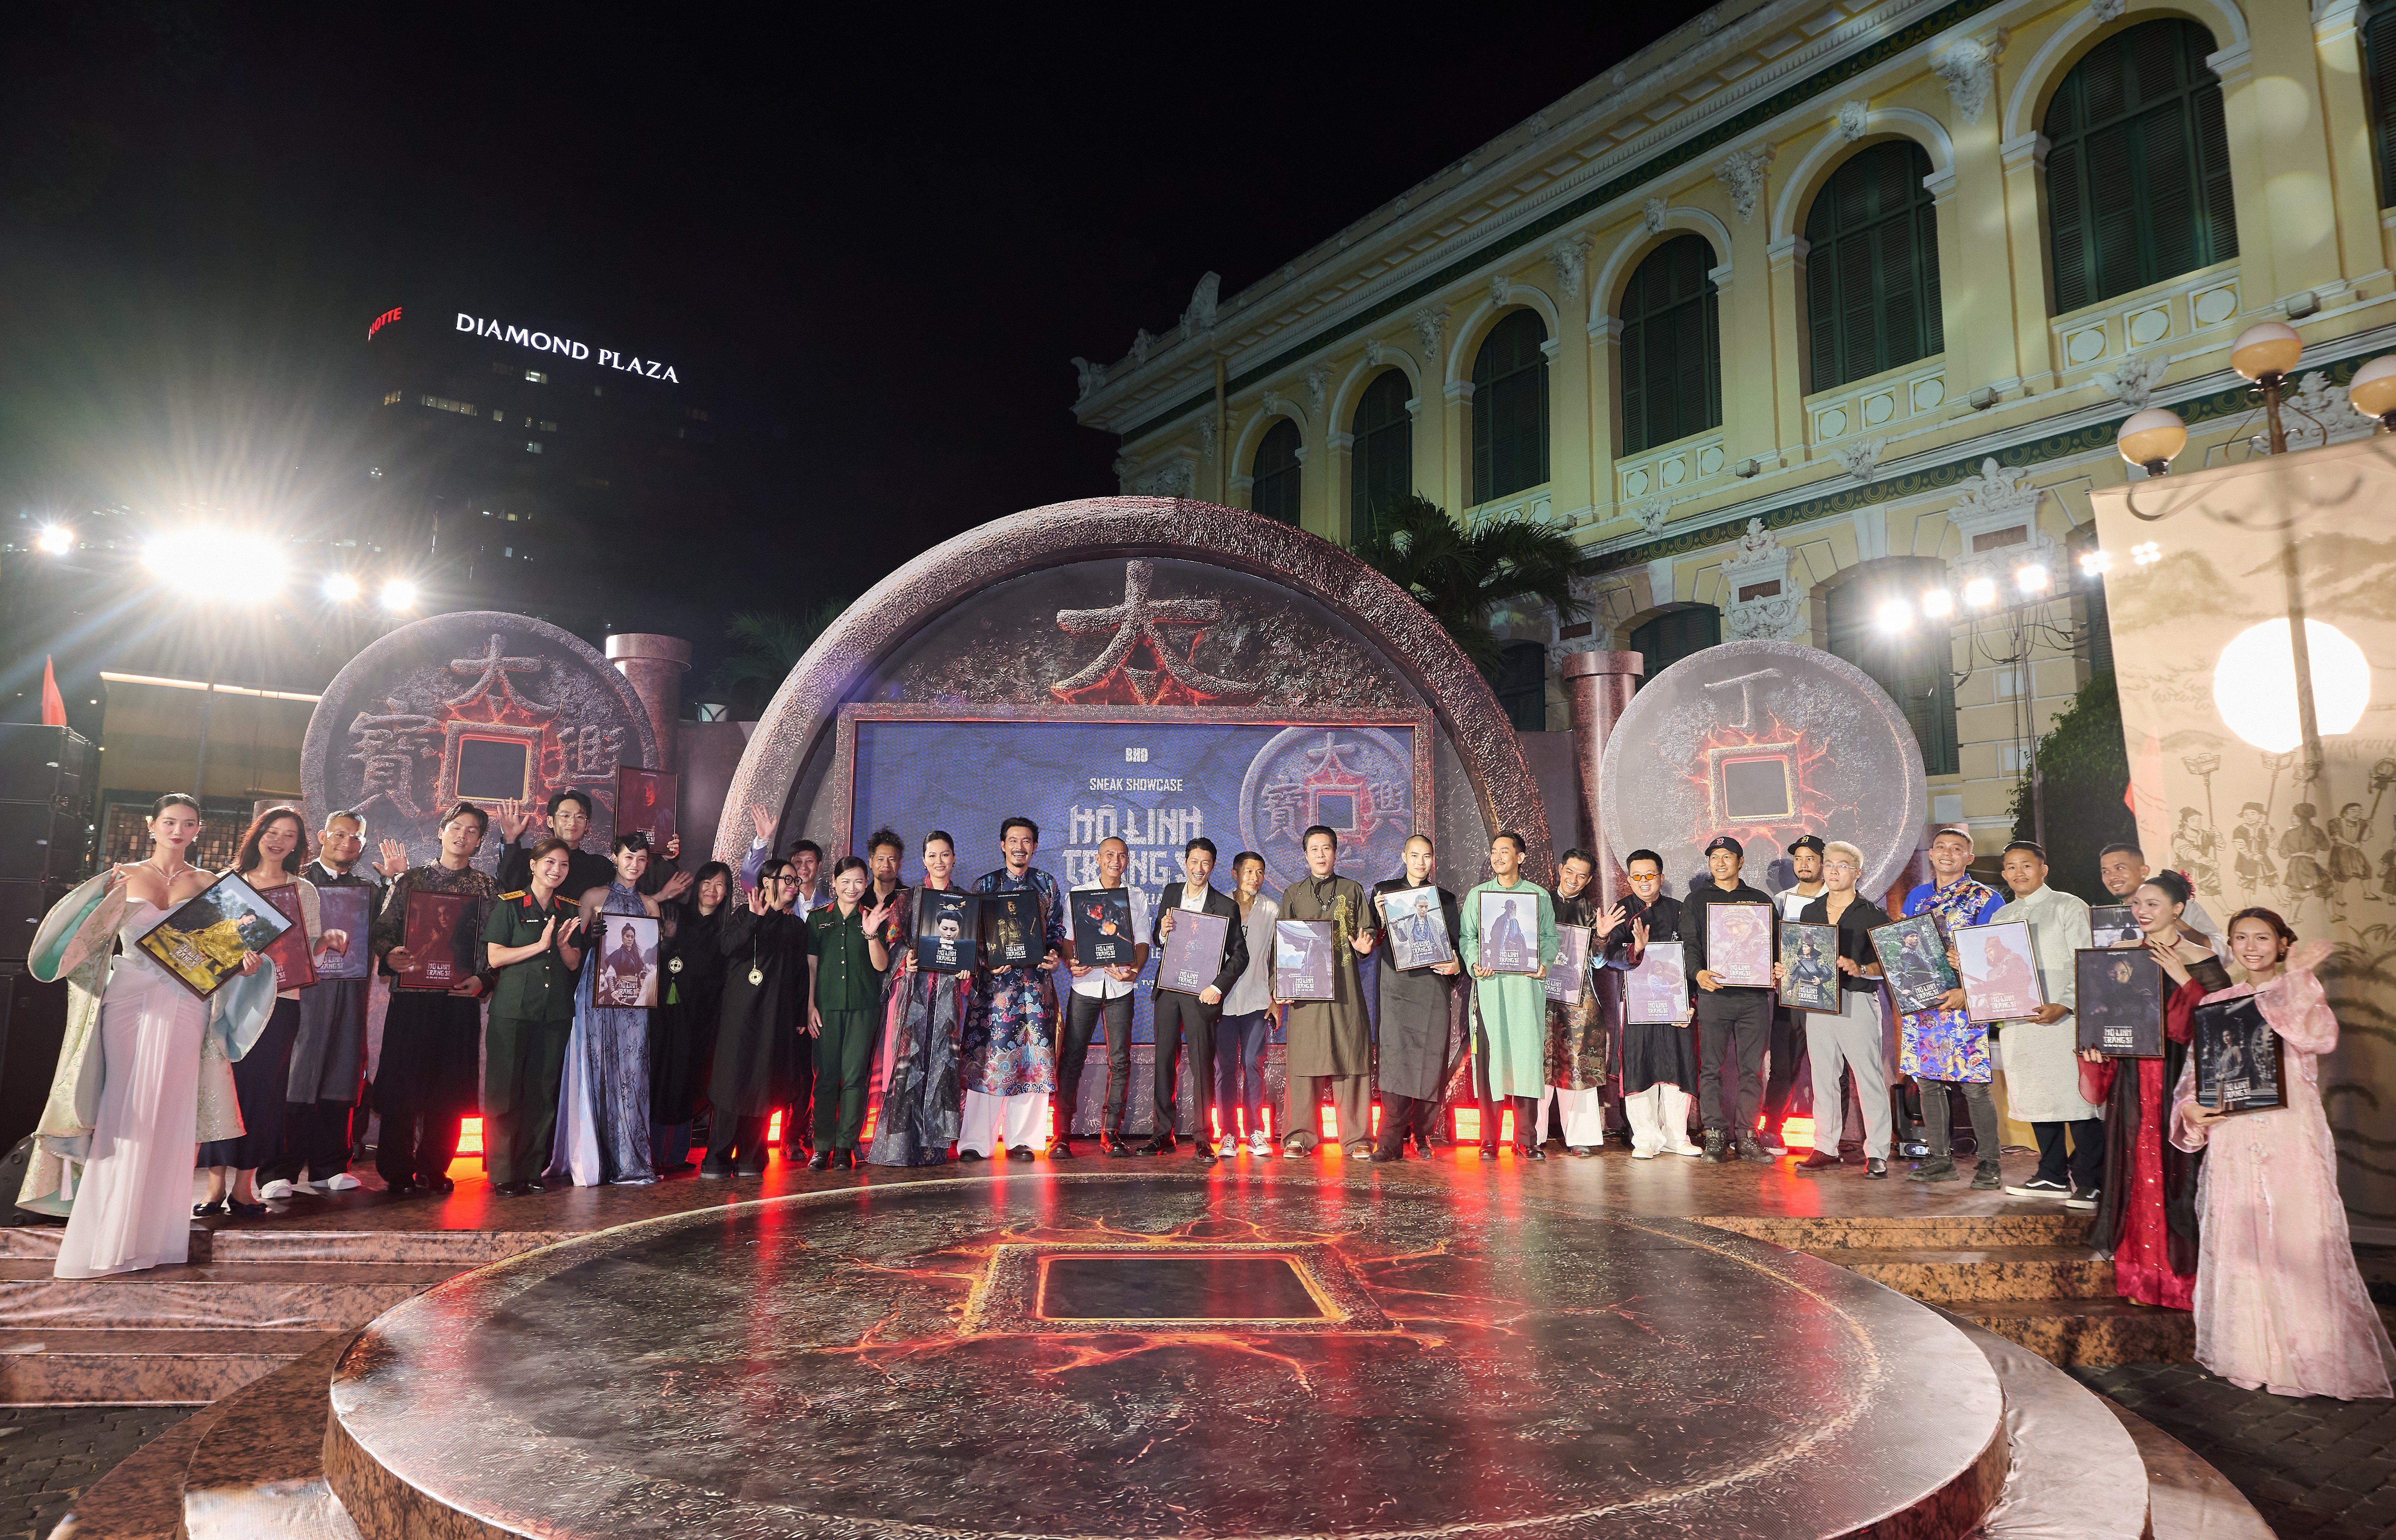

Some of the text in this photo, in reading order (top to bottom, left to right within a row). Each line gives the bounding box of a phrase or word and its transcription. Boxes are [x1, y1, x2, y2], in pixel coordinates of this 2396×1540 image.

[371, 307, 402, 334] LOTTE
[456, 313, 679, 384] DIAMOND PLAZA
[1125, 748, 1148, 762] BHD
[1089, 778, 1183, 791] SNEAK SHOWCASE
[1122, 805, 1203, 845] LINH
